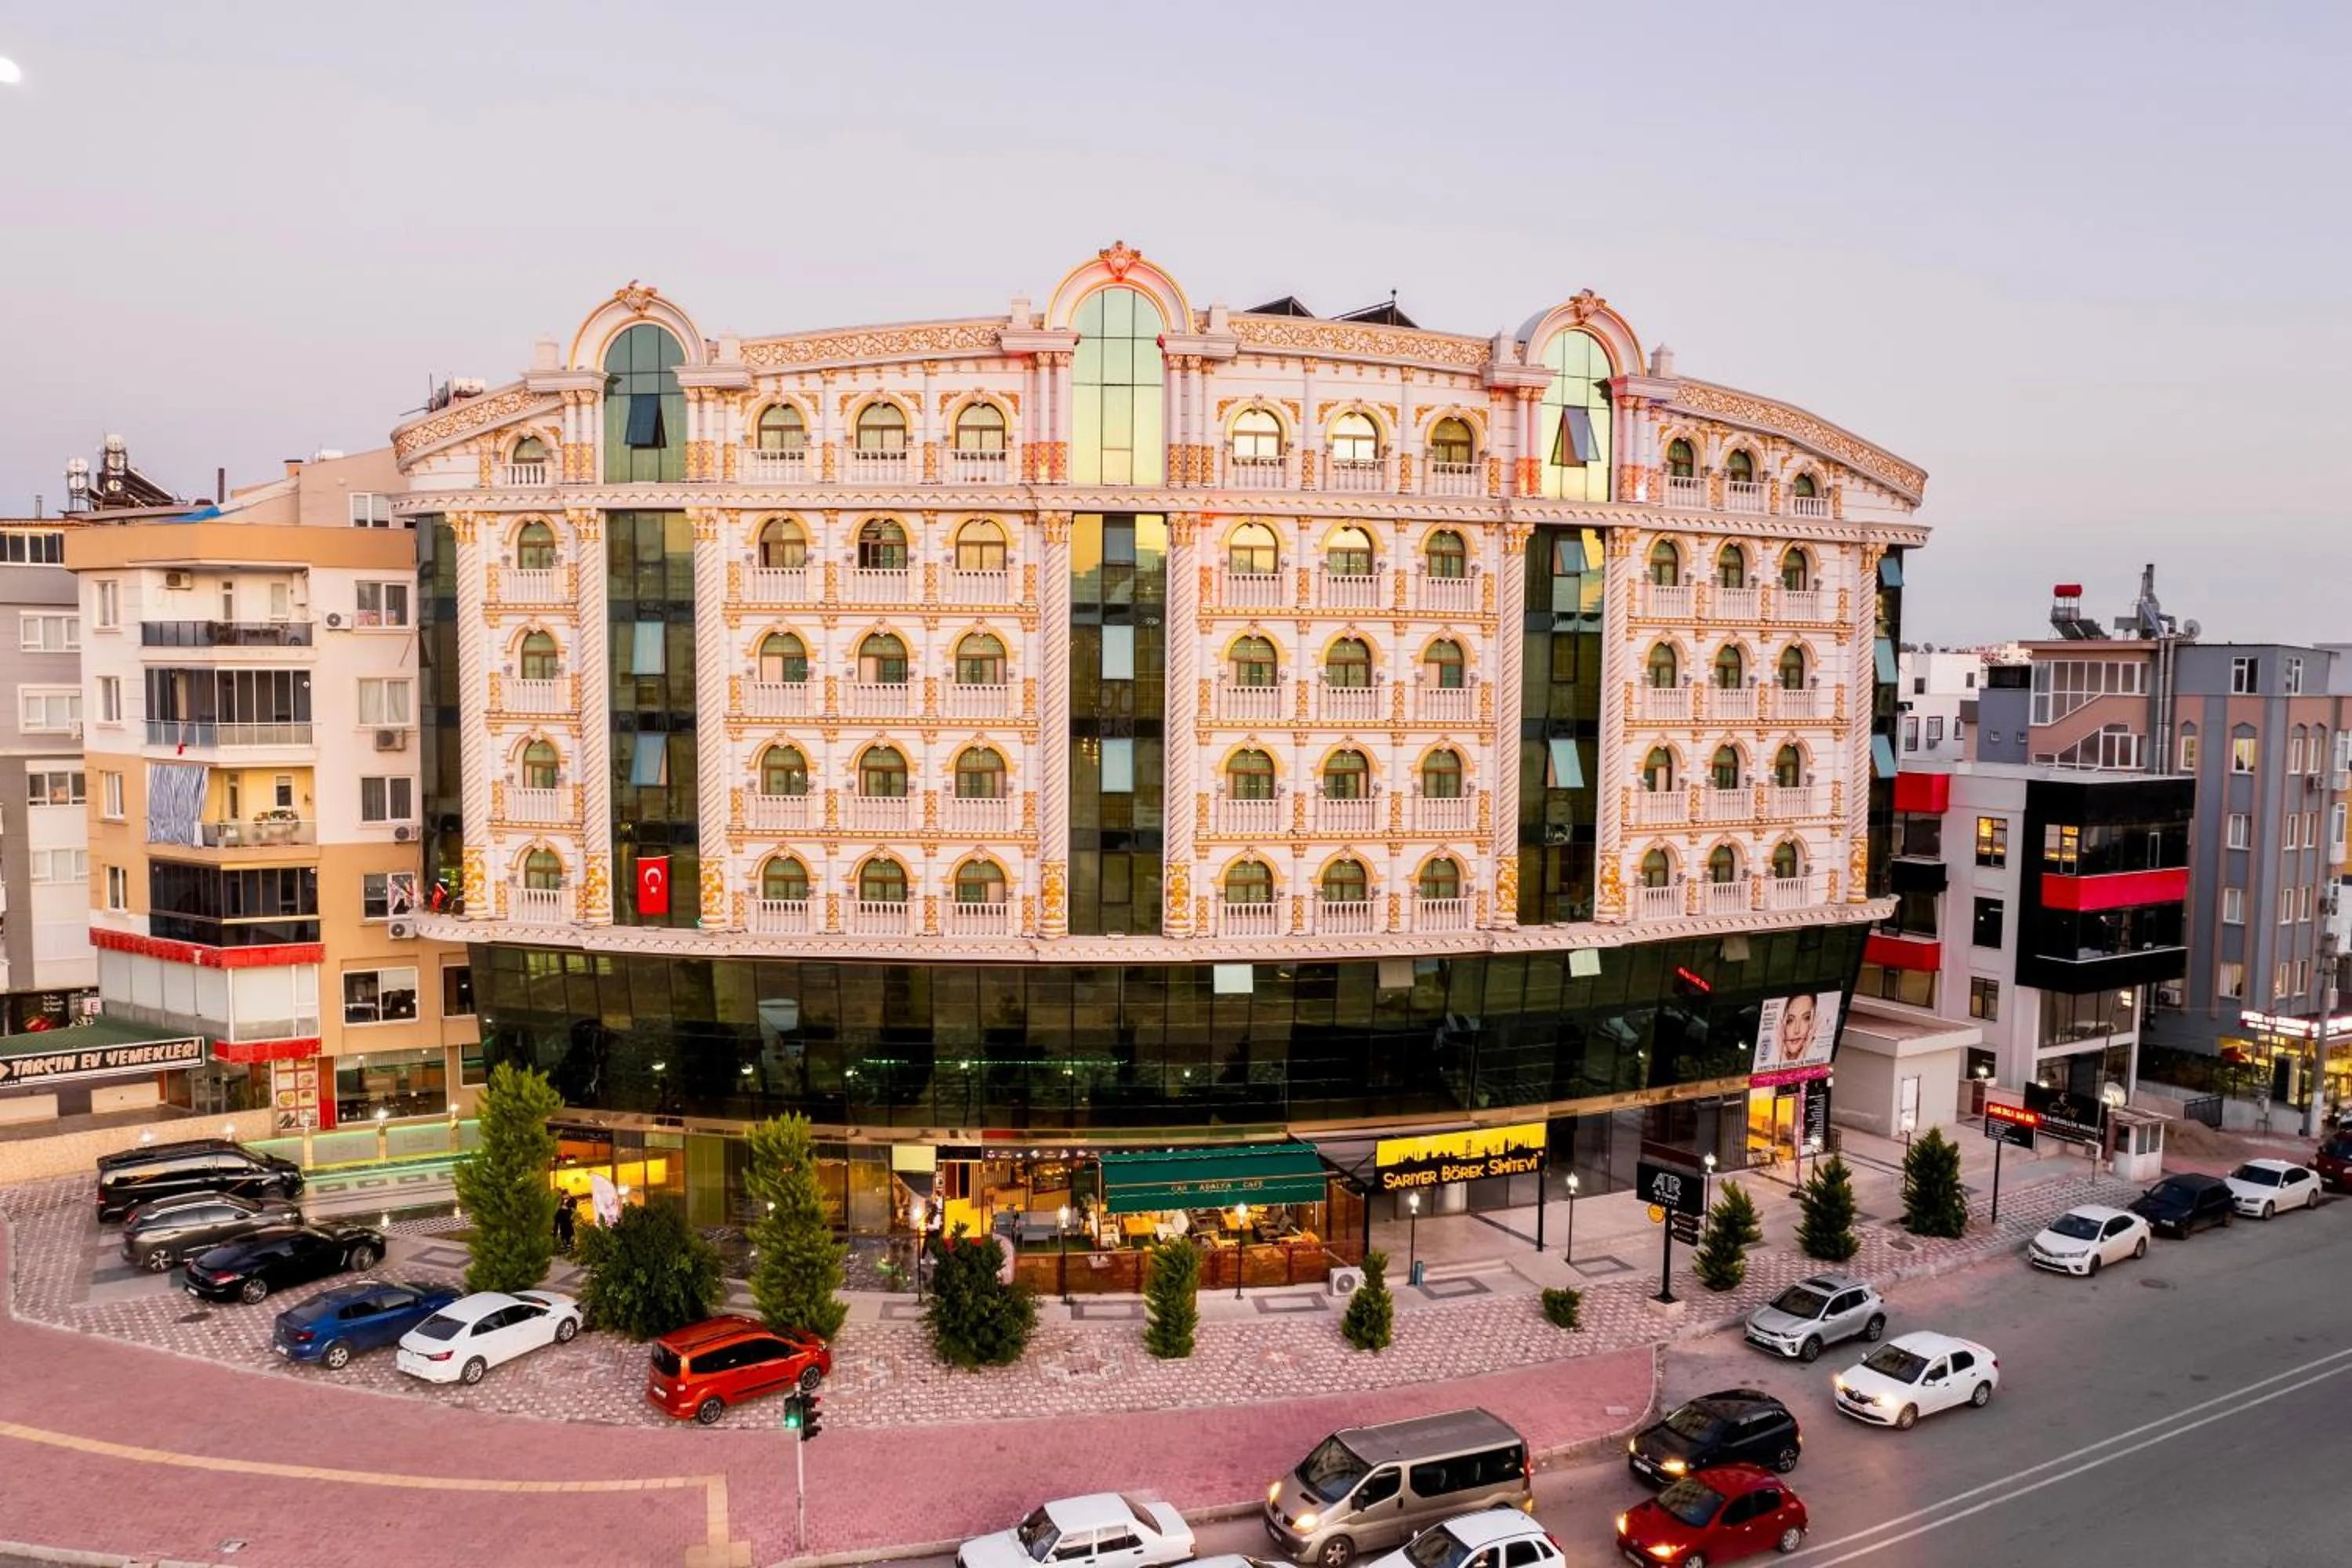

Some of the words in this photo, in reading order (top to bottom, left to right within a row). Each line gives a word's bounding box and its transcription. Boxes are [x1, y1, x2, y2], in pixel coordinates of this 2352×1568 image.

[12, 1054, 76, 1076] TARÇIN
[81, 1051, 101, 1069] EV
[1384, 1171, 1437, 1189] SARIYER
[1442, 1164, 1484, 1181] BÖREK
